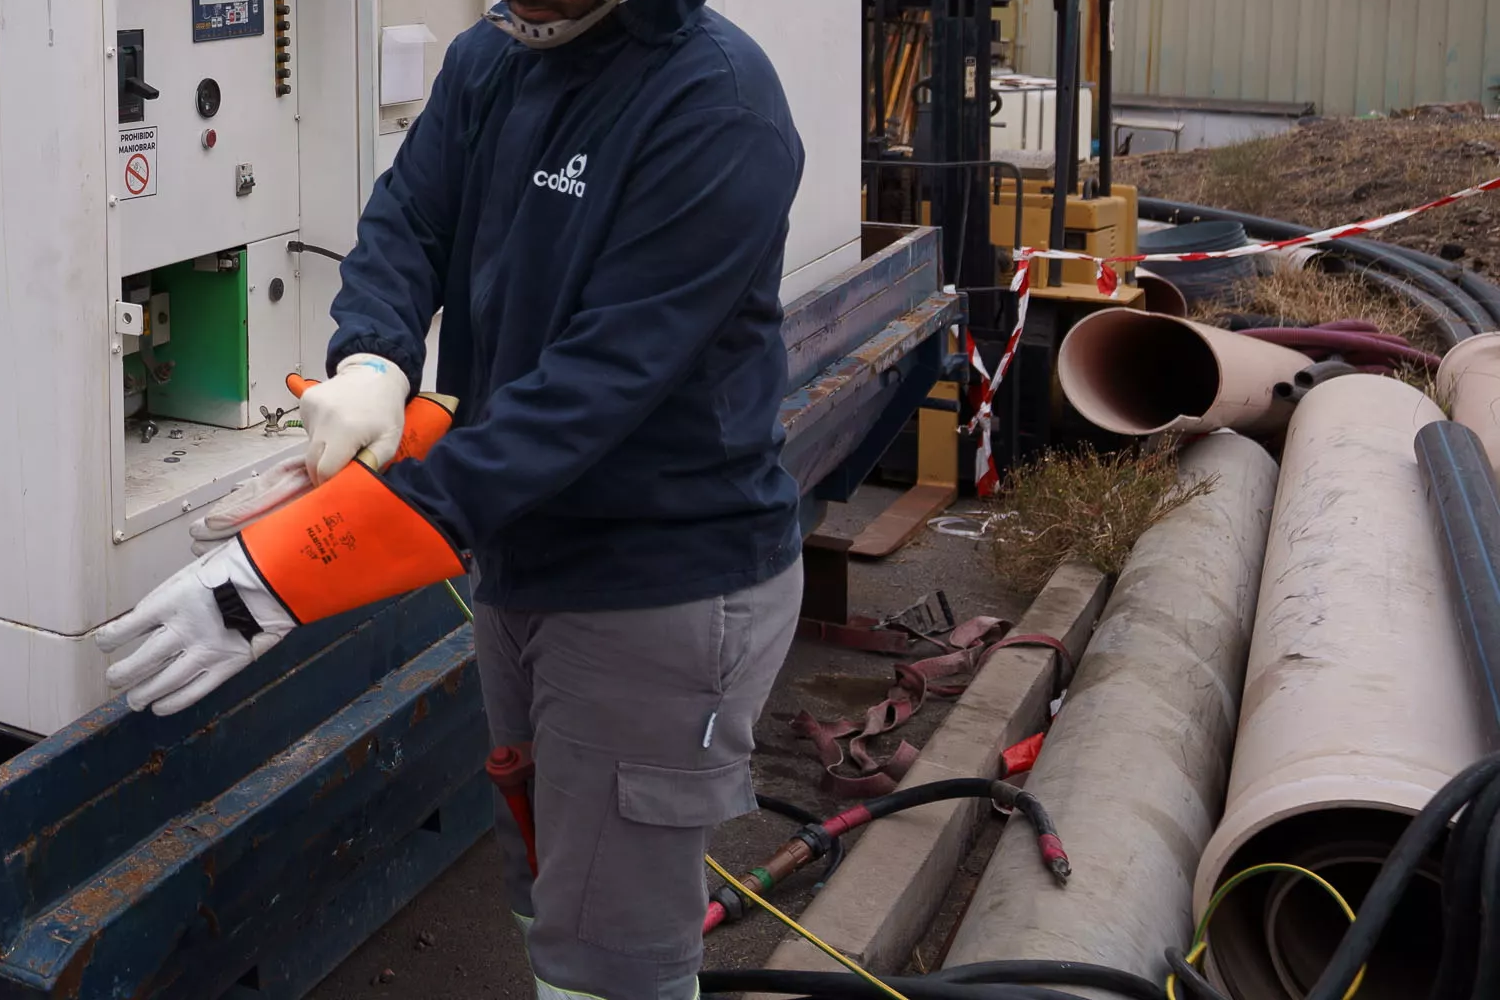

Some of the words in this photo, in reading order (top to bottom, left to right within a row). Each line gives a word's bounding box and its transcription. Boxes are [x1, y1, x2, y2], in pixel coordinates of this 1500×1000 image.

[120, 131, 154, 143] PROHIBIDO
[118, 141, 156, 154] MANIOBRAR
[533, 168, 586, 198] cobra
